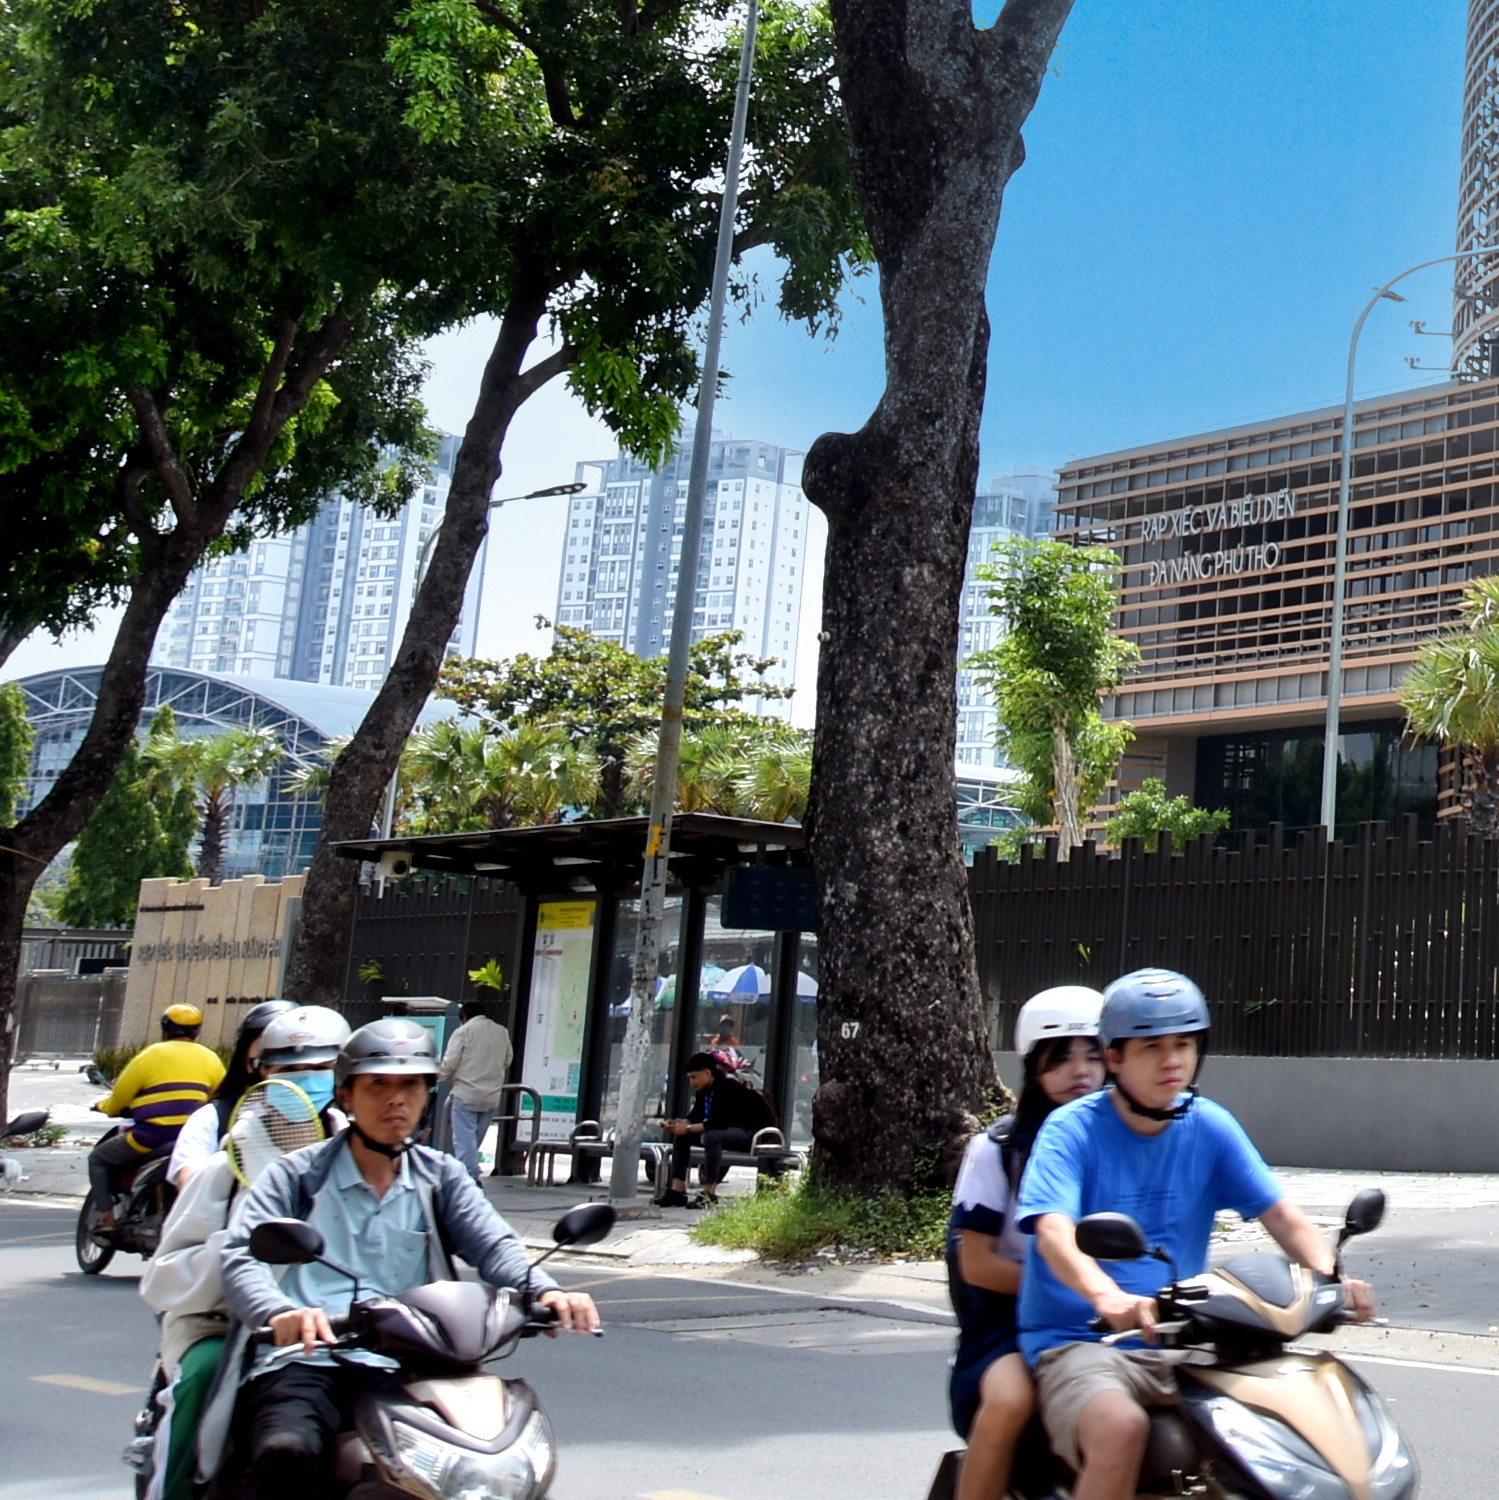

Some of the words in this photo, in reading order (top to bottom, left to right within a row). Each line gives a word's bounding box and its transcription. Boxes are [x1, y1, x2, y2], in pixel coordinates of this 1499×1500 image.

[1141, 514, 1168, 546] RẠP
[1170, 504, 1203, 538] XIẾC
[1230, 493, 1261, 529] BIỂU
[1263, 487, 1297, 522] DIỄN
[1149, 560, 1168, 587] ĐA
[1170, 550, 1213, 585] NĂNG
[1214, 542, 1245, 577] PHÚ
[841, 1021, 860, 1040] 67
